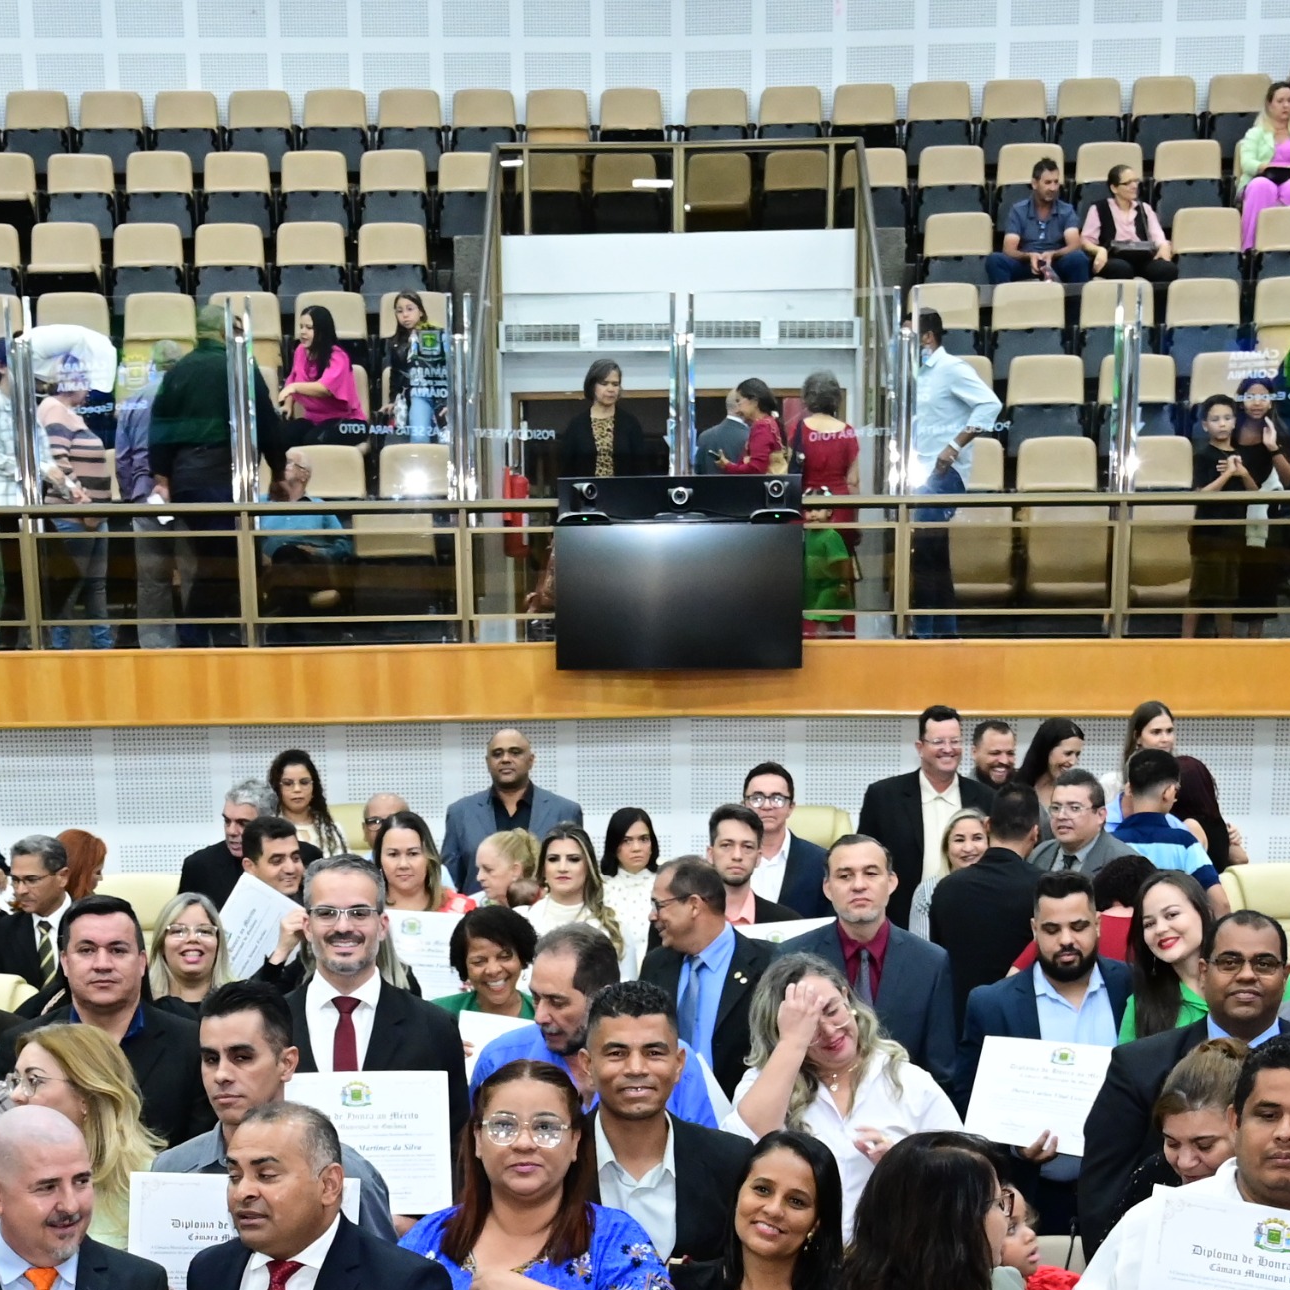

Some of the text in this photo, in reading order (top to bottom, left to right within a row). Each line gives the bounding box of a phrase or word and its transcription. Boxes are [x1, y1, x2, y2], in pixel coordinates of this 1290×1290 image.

[392, 1143, 401, 1151] da
[170, 1218, 228, 1230] Diploma de
[187, 1232, 218, 1241] Câmara
[1191, 1243, 1238, 1262] Diploma
[1241, 1253, 1253, 1264] de
[1208, 1262, 1241, 1275] Câmara
[1243, 1269, 1286, 1283] Municipal
